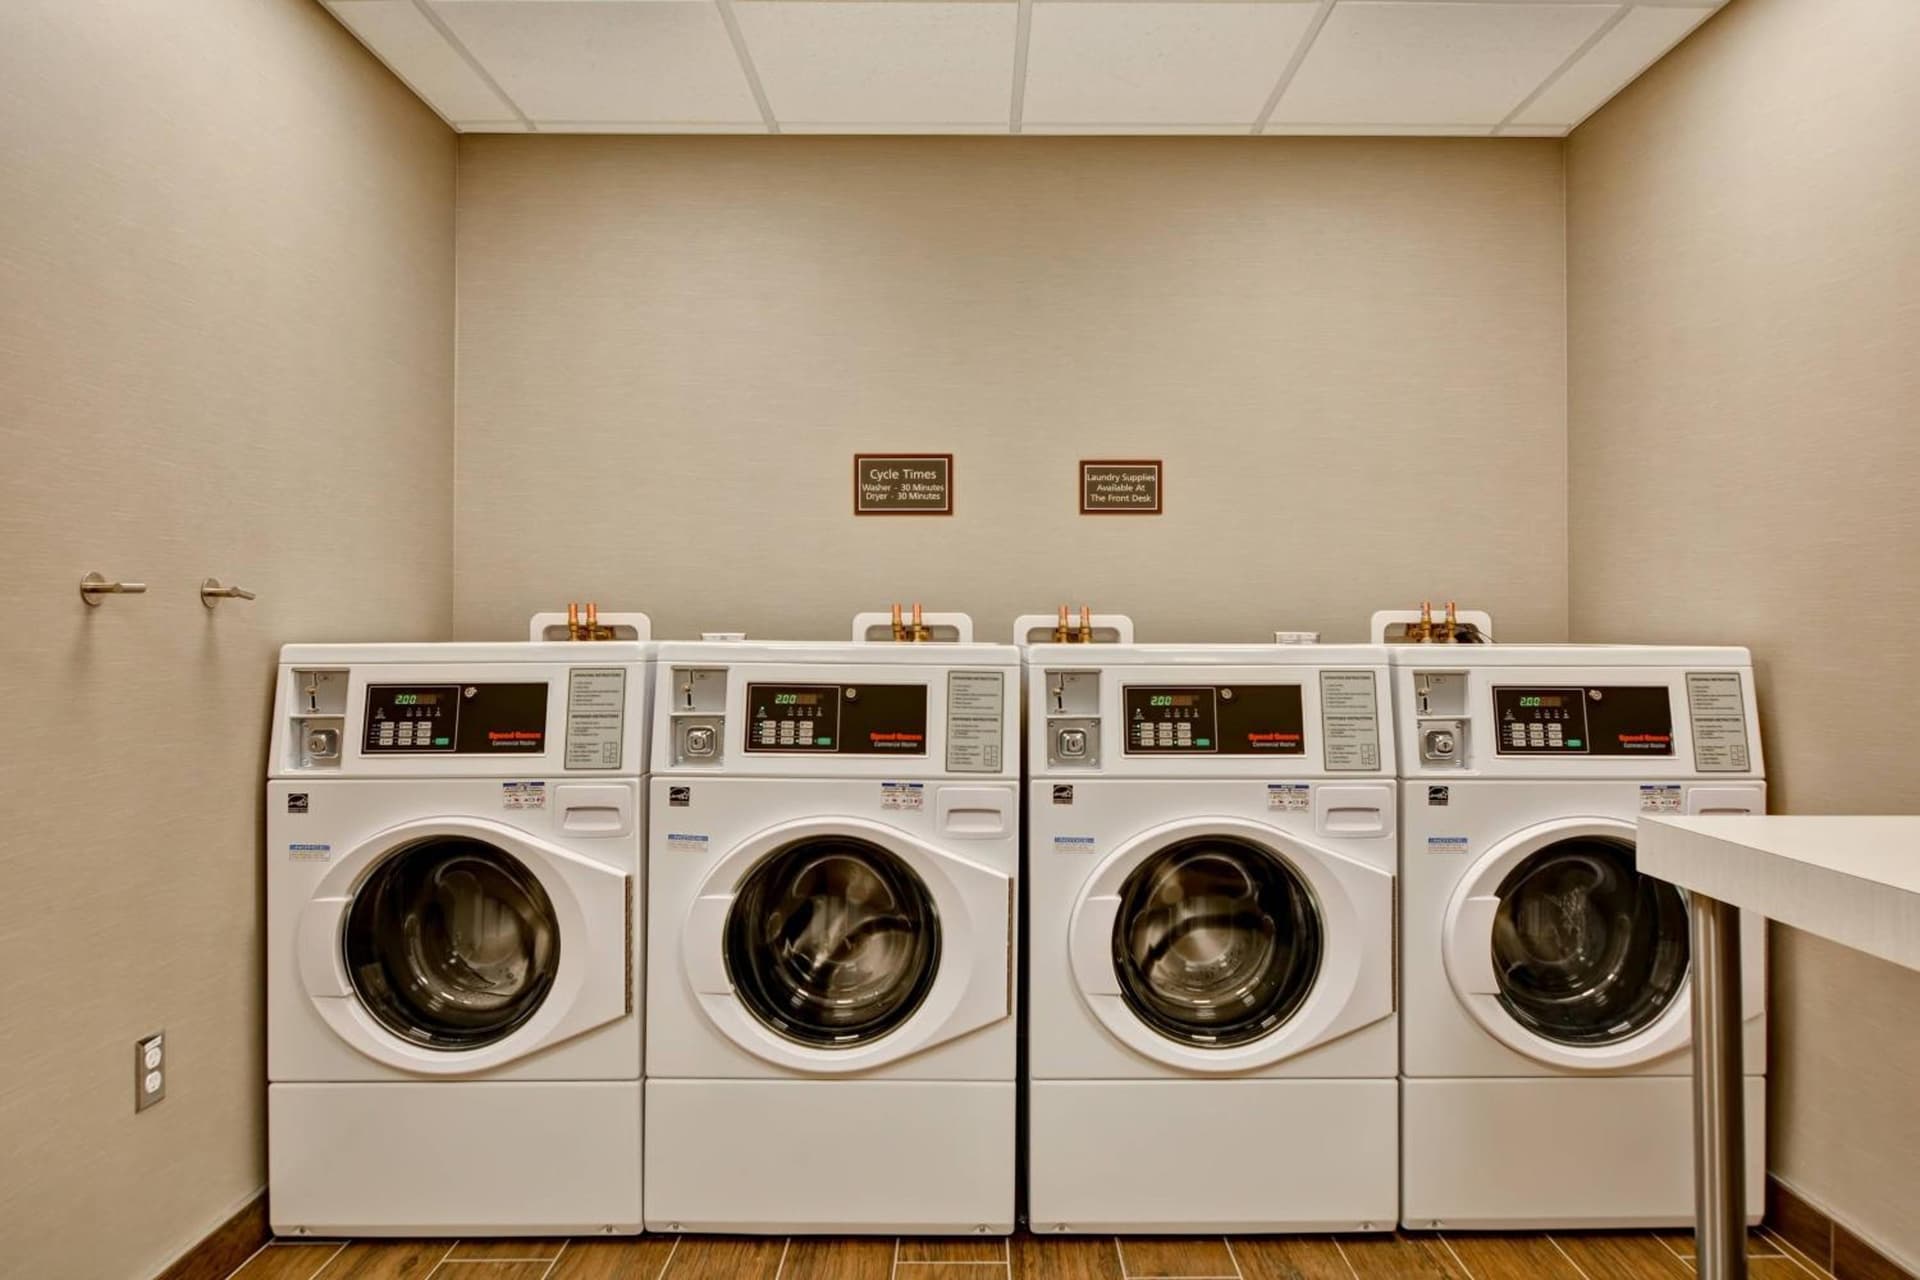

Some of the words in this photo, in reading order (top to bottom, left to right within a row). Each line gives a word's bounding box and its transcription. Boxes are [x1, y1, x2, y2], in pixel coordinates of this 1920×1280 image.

[870, 468, 900, 482] Cycle
[902, 468, 937, 480] Times
[1087, 473, 1120, 483] Laundry
[1121, 473, 1156, 483] Supplies
[861, 483, 891, 492] Washer
[900, 483, 911, 492] 30
[912, 483, 945, 492] Minutes
[1096, 484, 1134, 493] Available
[1135, 484, 1146, 493] At
[865, 492, 888, 502] Dryer
[897, 492, 908, 501] 30
[908, 492, 941, 501] Minutes
[1090, 494, 1106, 503] The
[1107, 494, 1130, 503] Front
[1131, 493, 1152, 503] Desk
